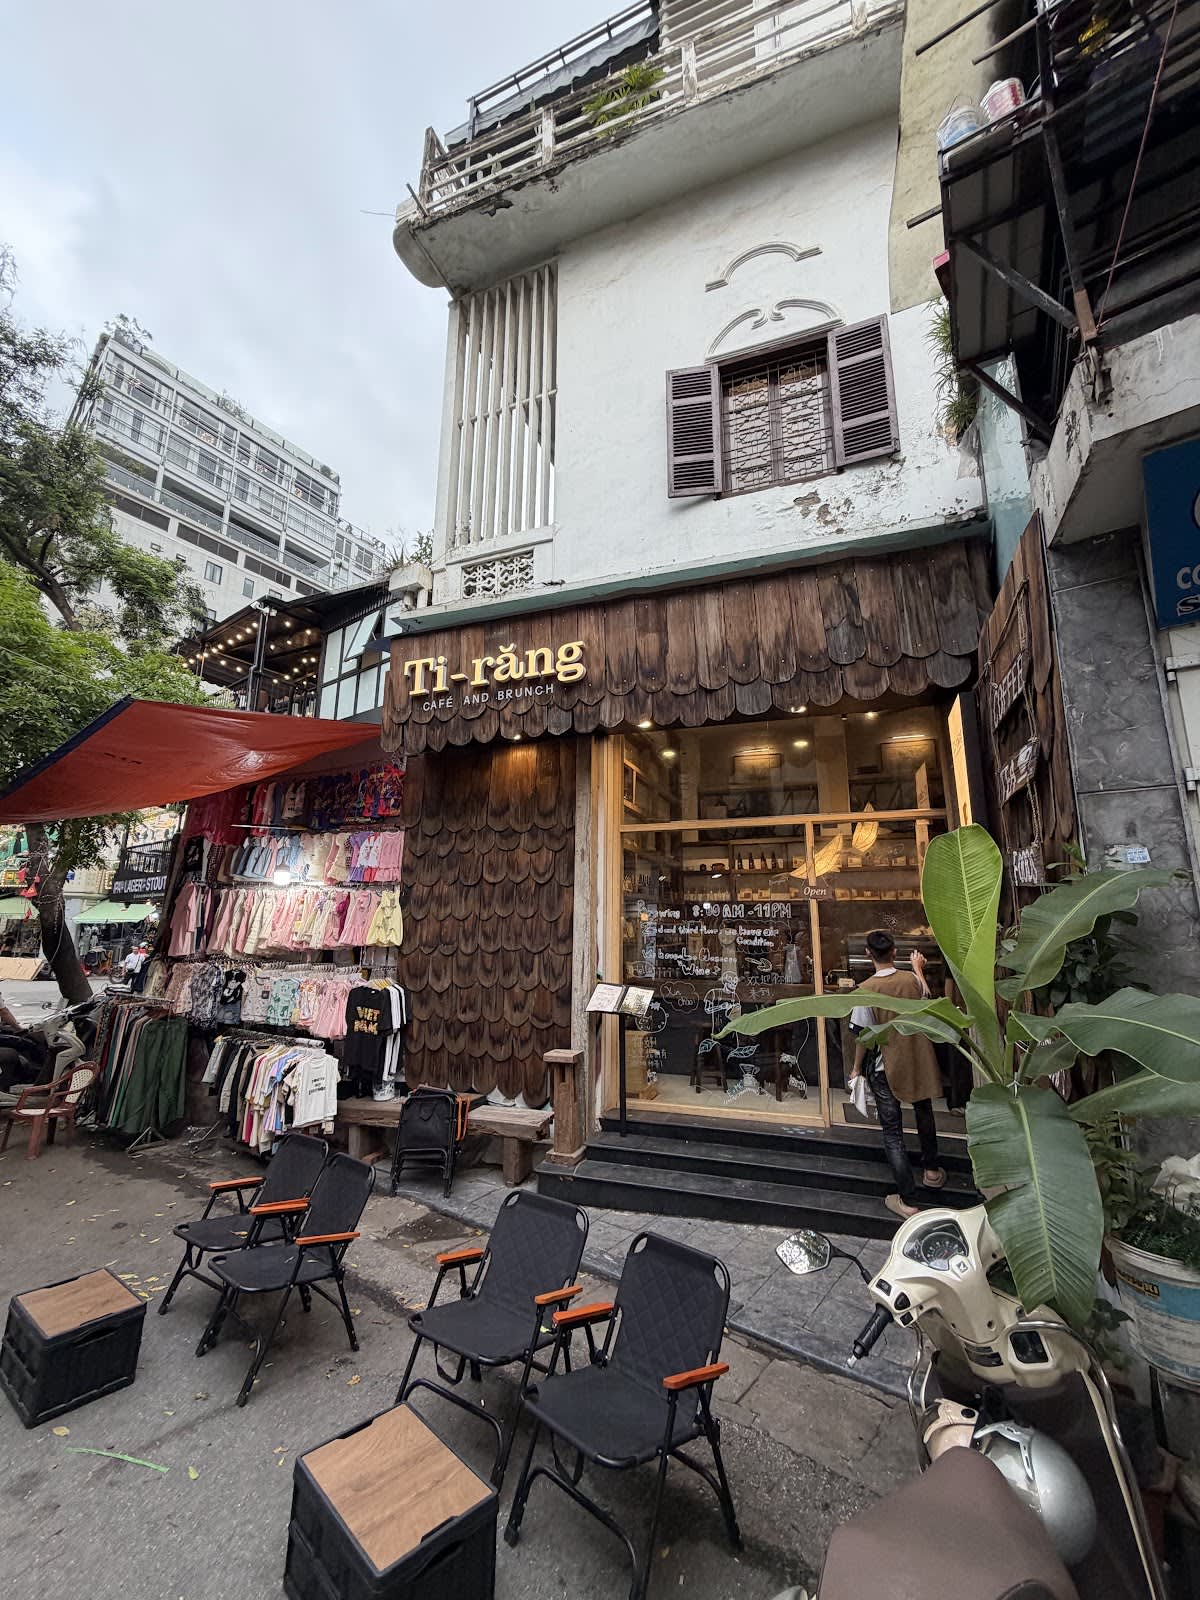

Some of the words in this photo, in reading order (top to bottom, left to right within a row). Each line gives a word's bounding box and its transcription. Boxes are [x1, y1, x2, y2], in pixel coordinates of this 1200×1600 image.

[404, 641, 587, 697] Ti-răng
[423, 696, 454, 712] CAFÉ
[463, 692, 489, 705] AND
[497, 684, 555, 700] BRUNCH
[993, 653, 1025, 728] COFFEE
[999, 759, 1017, 801] TEA
[145, 876, 167, 891] STOUT
[803, 886, 827, 897] Open
[722, 903, 745, 918] AM
